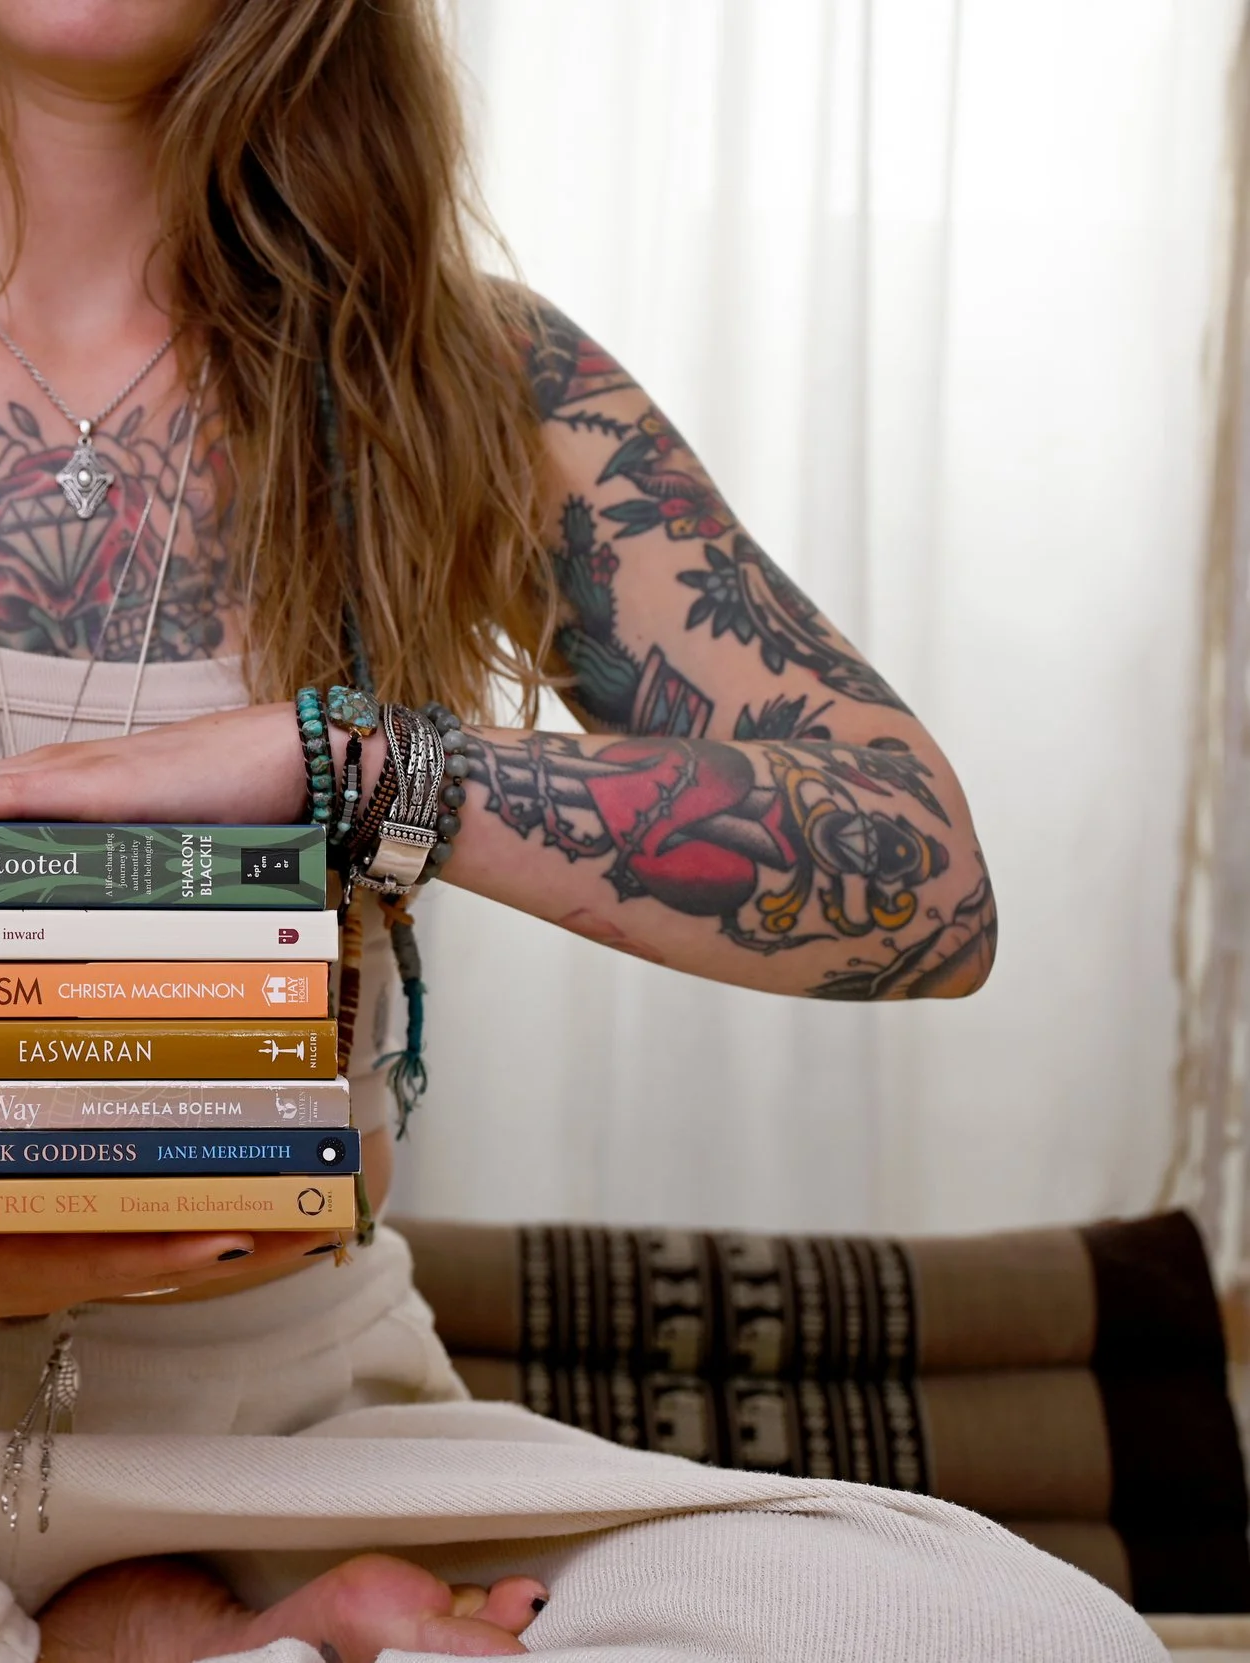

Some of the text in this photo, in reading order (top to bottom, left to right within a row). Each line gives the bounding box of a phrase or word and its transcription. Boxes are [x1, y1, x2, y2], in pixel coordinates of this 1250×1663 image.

[105, 833, 115, 889] life-changing
[119, 843, 128, 888] journey to
[131, 839, 141, 891] authenticity
[144, 835, 154, 895] and belonging
[181, 834, 194, 898] SHARON
[200, 834, 212, 896] BLACKIE
[2, 927, 45, 940] inward
[58, 983, 244, 999] CHRISTA MACKINNON
[287, 976, 299, 1003] HAY
[19, 1040, 152, 1063] EASWARAN
[81, 1102, 242, 1115] MICHAELA BOEHM
[23, 1143, 137, 1162] GODDESS
[157, 1145, 291, 1161] JANE MEREDITH
[55, 1194, 98, 1213] SEX
[120, 1194, 274, 1213] Diana Richardson
